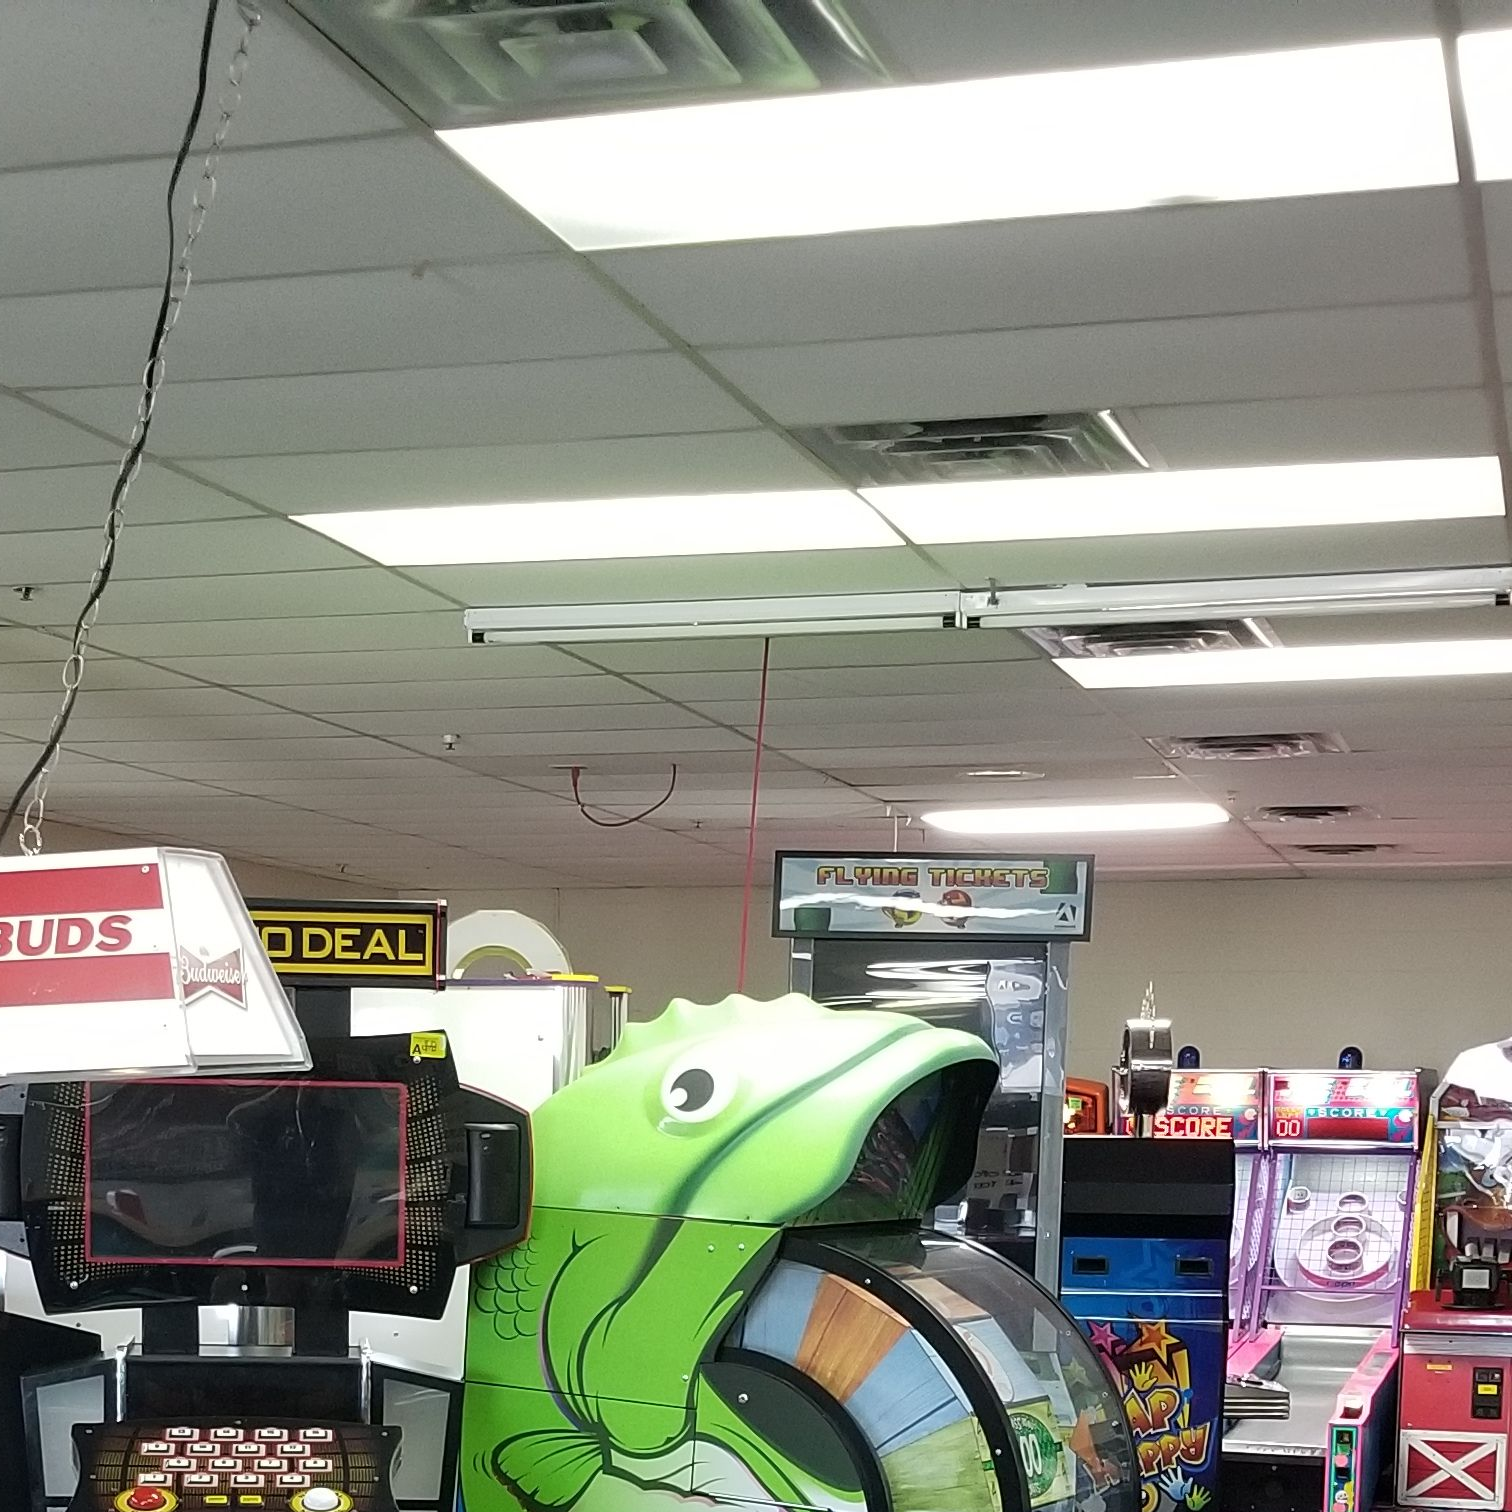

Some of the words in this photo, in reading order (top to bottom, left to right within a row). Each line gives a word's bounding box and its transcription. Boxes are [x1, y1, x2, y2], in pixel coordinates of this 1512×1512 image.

[816, 866, 919, 887] FLYING
[928, 867, 1049, 888] TICKETS
[255, 927, 293, 958] O
[302, 928, 424, 961] DEAL
[180, 955, 248, 985] Budweiser
[413, 1044, 422, 1055] A
[1166, 1105, 1223, 1116] SCORE
[1317, 1107, 1378, 1118] SCORE
[1154, 1116, 1233, 1138] SCORE
[1276, 1119, 1301, 1137] 00
[1124, 1387, 1181, 1436] AP
[1136, 1421, 1211, 1477] PPY
